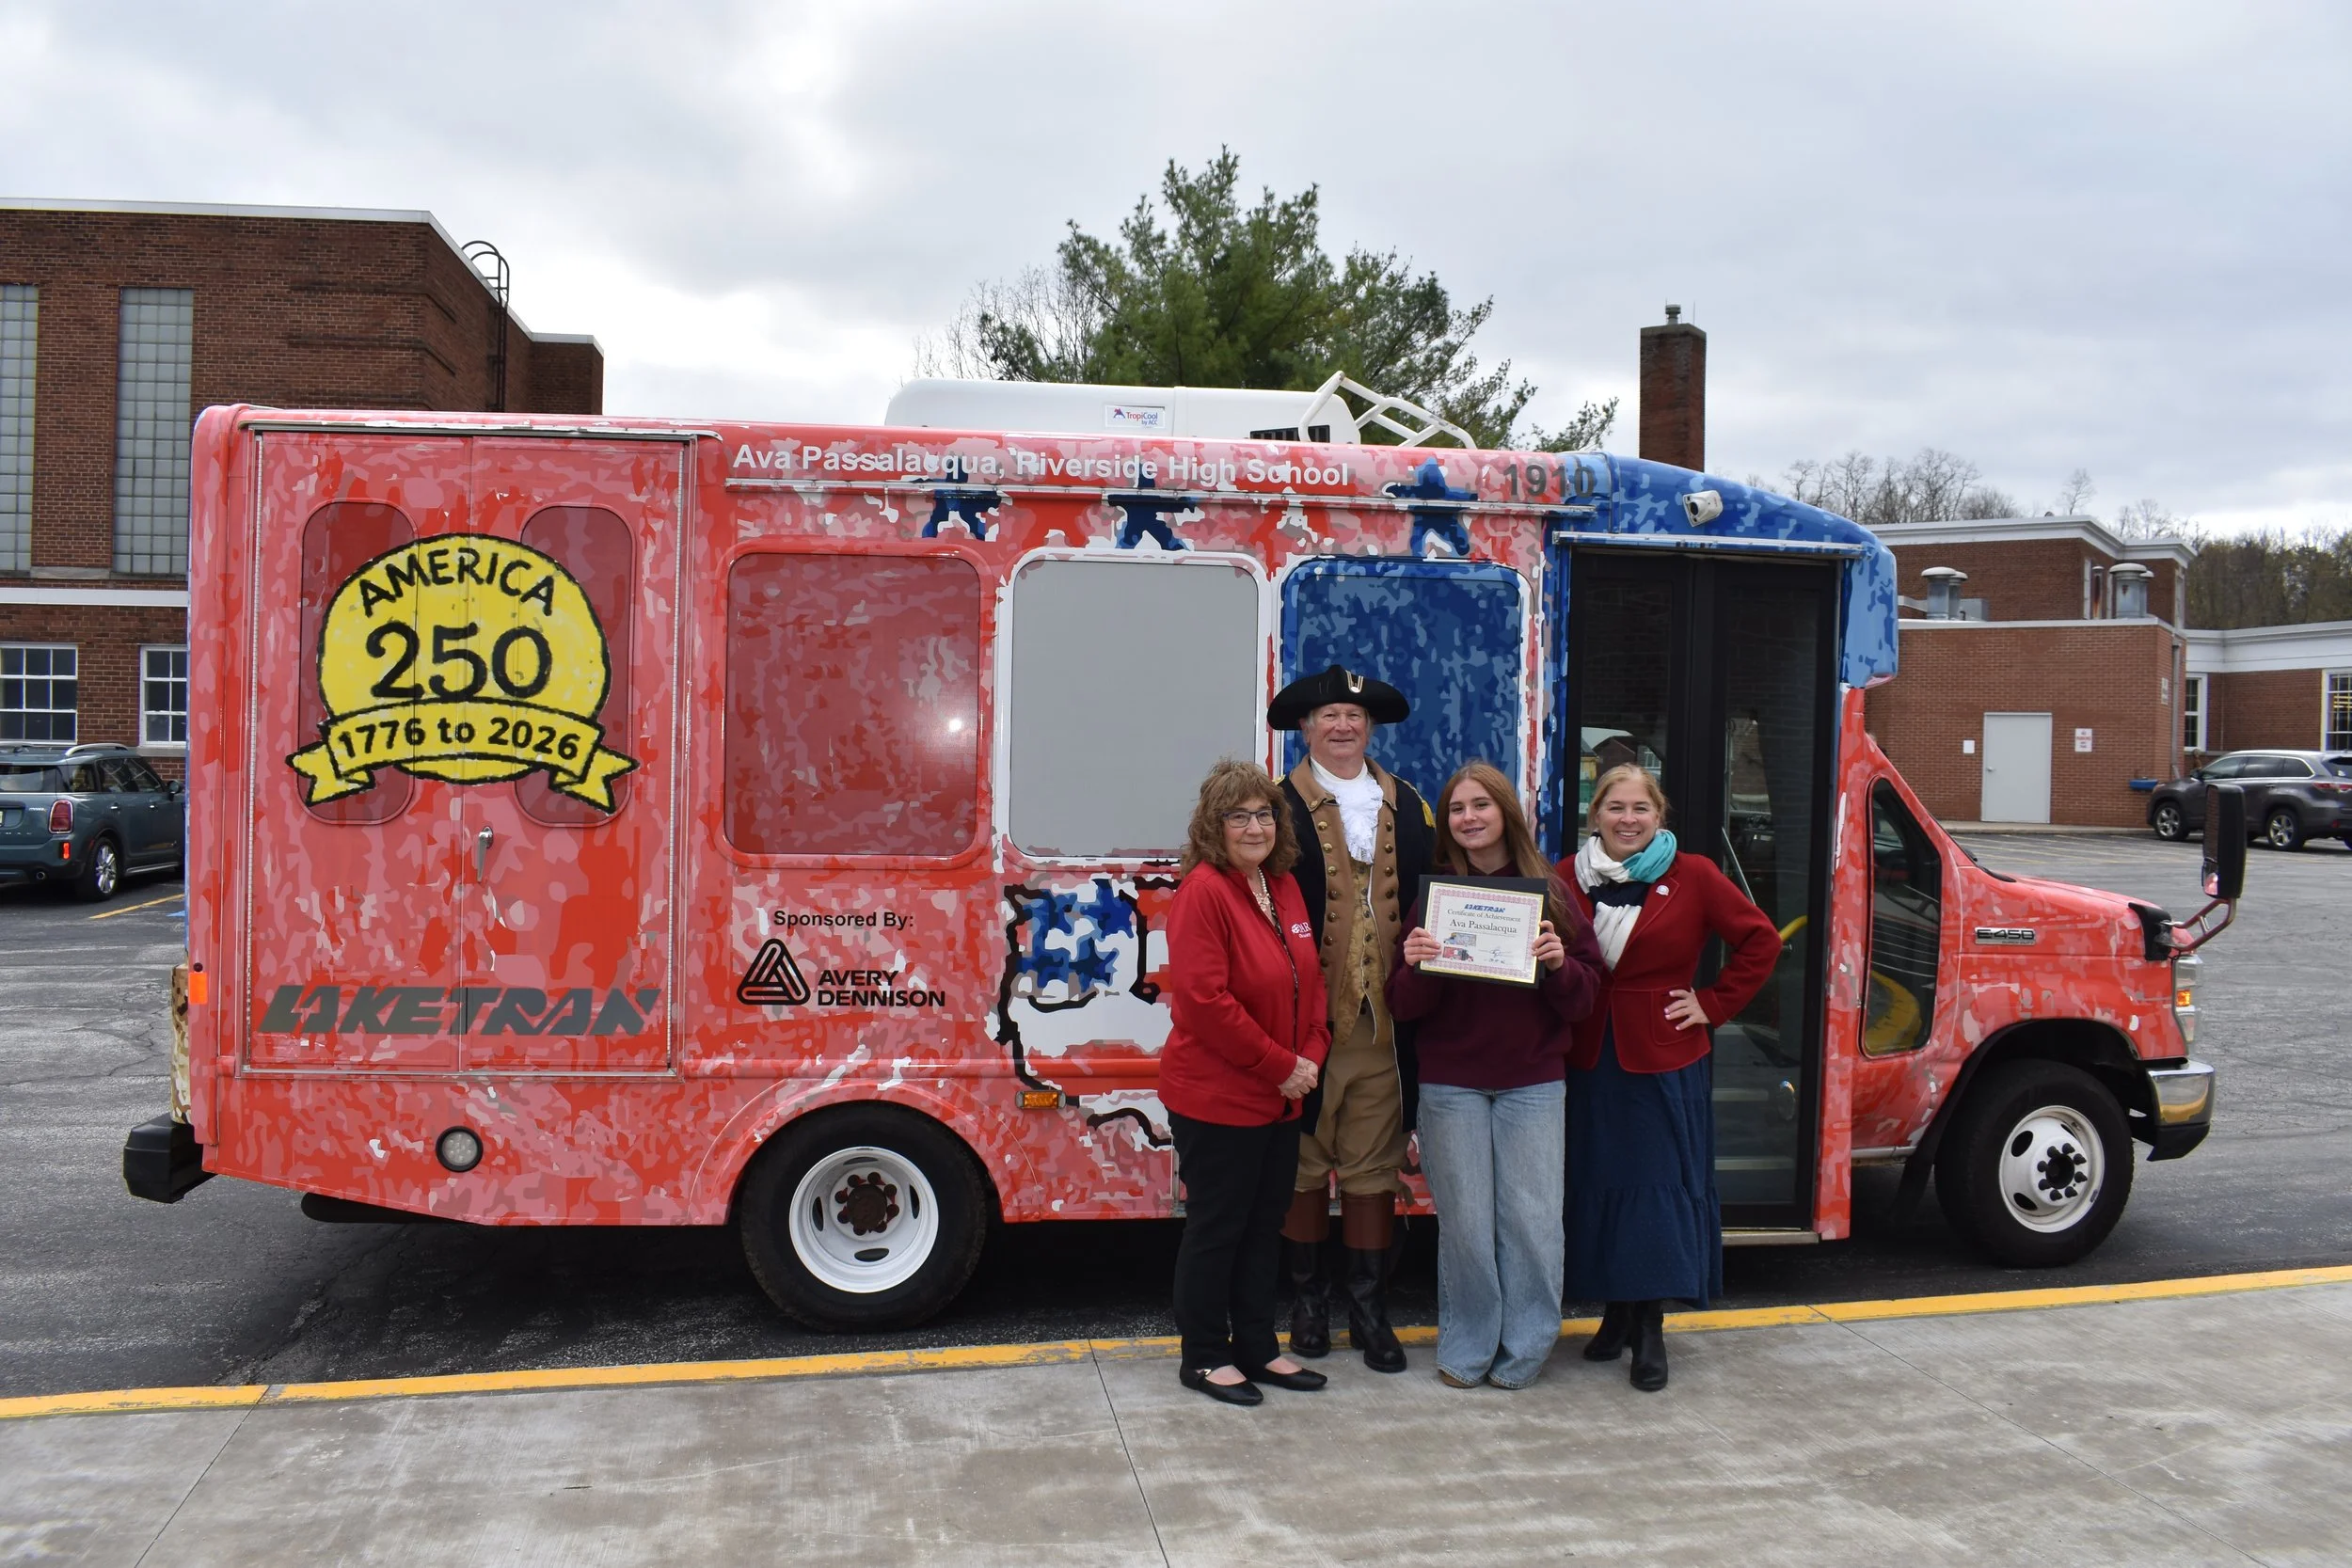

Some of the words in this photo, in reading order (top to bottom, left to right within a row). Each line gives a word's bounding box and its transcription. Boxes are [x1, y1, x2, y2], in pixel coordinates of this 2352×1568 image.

[1126, 411, 1158, 421] TropiCool
[732, 444, 791, 469] Ava
[802, 446, 1005, 480] Passalacqua,
[1016, 450, 1158, 480] Riverside
[1168, 456, 1236, 487] High
[1247, 459, 1348, 486] School
[1503, 463, 1596, 498] 1910
[358, 548, 554, 617] AMERICA
[366, 621, 553, 700] 250
[338, 718, 426, 758] 1776
[437, 717, 475, 744] to
[487, 717, 581, 760] 2026
[773, 911, 878, 929] Sponsored
[883, 911, 914, 930] By:
[1450, 918, 1466, 928] Ava
[1469, 920, 1518, 934] Passalacqua
[818, 970, 899, 987] AVERY
[259, 985, 662, 1036] LAKETRAN
[818, 990, 946, 1007] DENNISON
